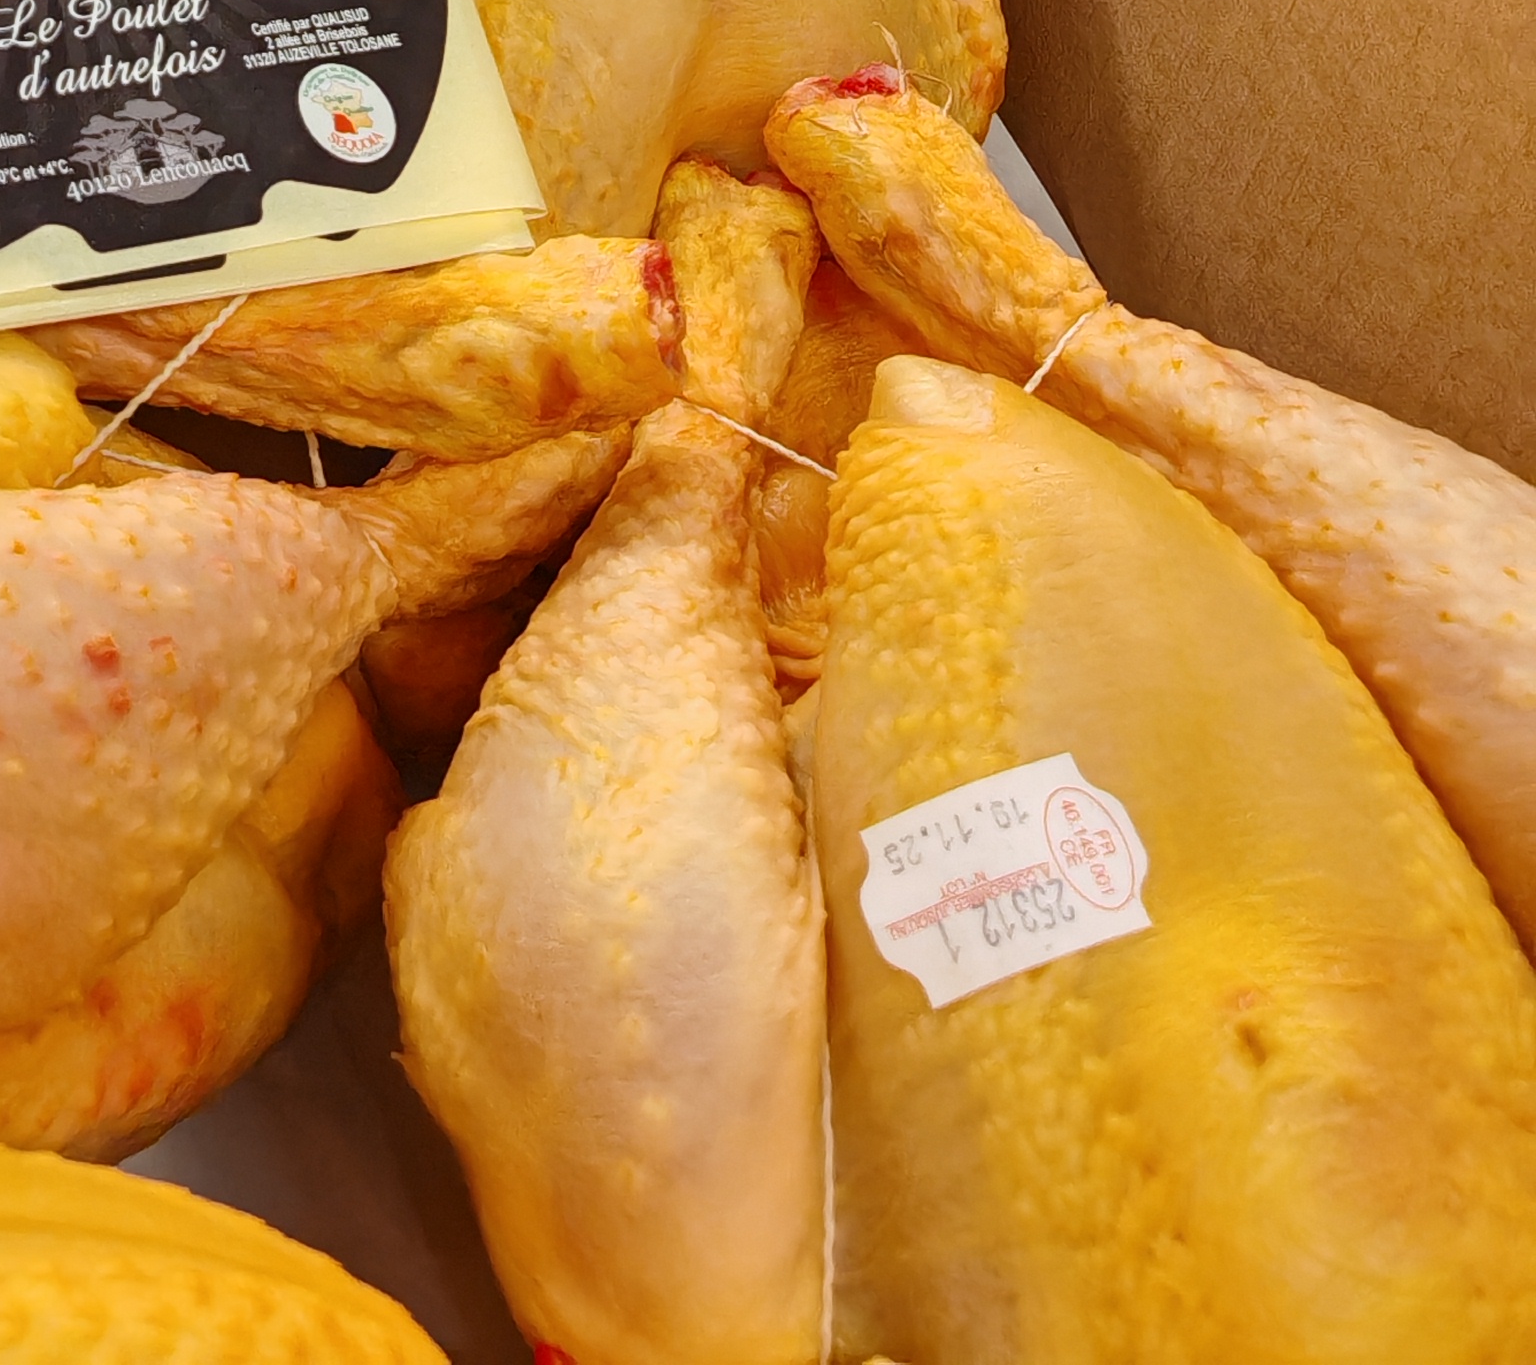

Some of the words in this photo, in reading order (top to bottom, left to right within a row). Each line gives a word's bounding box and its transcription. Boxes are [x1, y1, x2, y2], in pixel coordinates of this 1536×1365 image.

[251, 17, 291, 36] Certifié
[292, 17, 310, 33] par
[311, 7, 371, 28] QUALISUD
[265, 36, 275, 49] 2
[275, 33, 301, 48] allée
[302, 31, 316, 45] de
[316, 24, 369, 42] Brisebois
[19, 34, 226, 101] d'autrefois
[243, 51, 276, 70] 31320
[278, 42, 340, 64] AUZEVILLE
[338, 33, 402, 55] TOLOSANE
[23, 164, 37, 179] et
[66, 169, 132, 203] 40120
[138, 150, 252, 187] Lencouacq
[970, 877, 1077, 948] 25312
